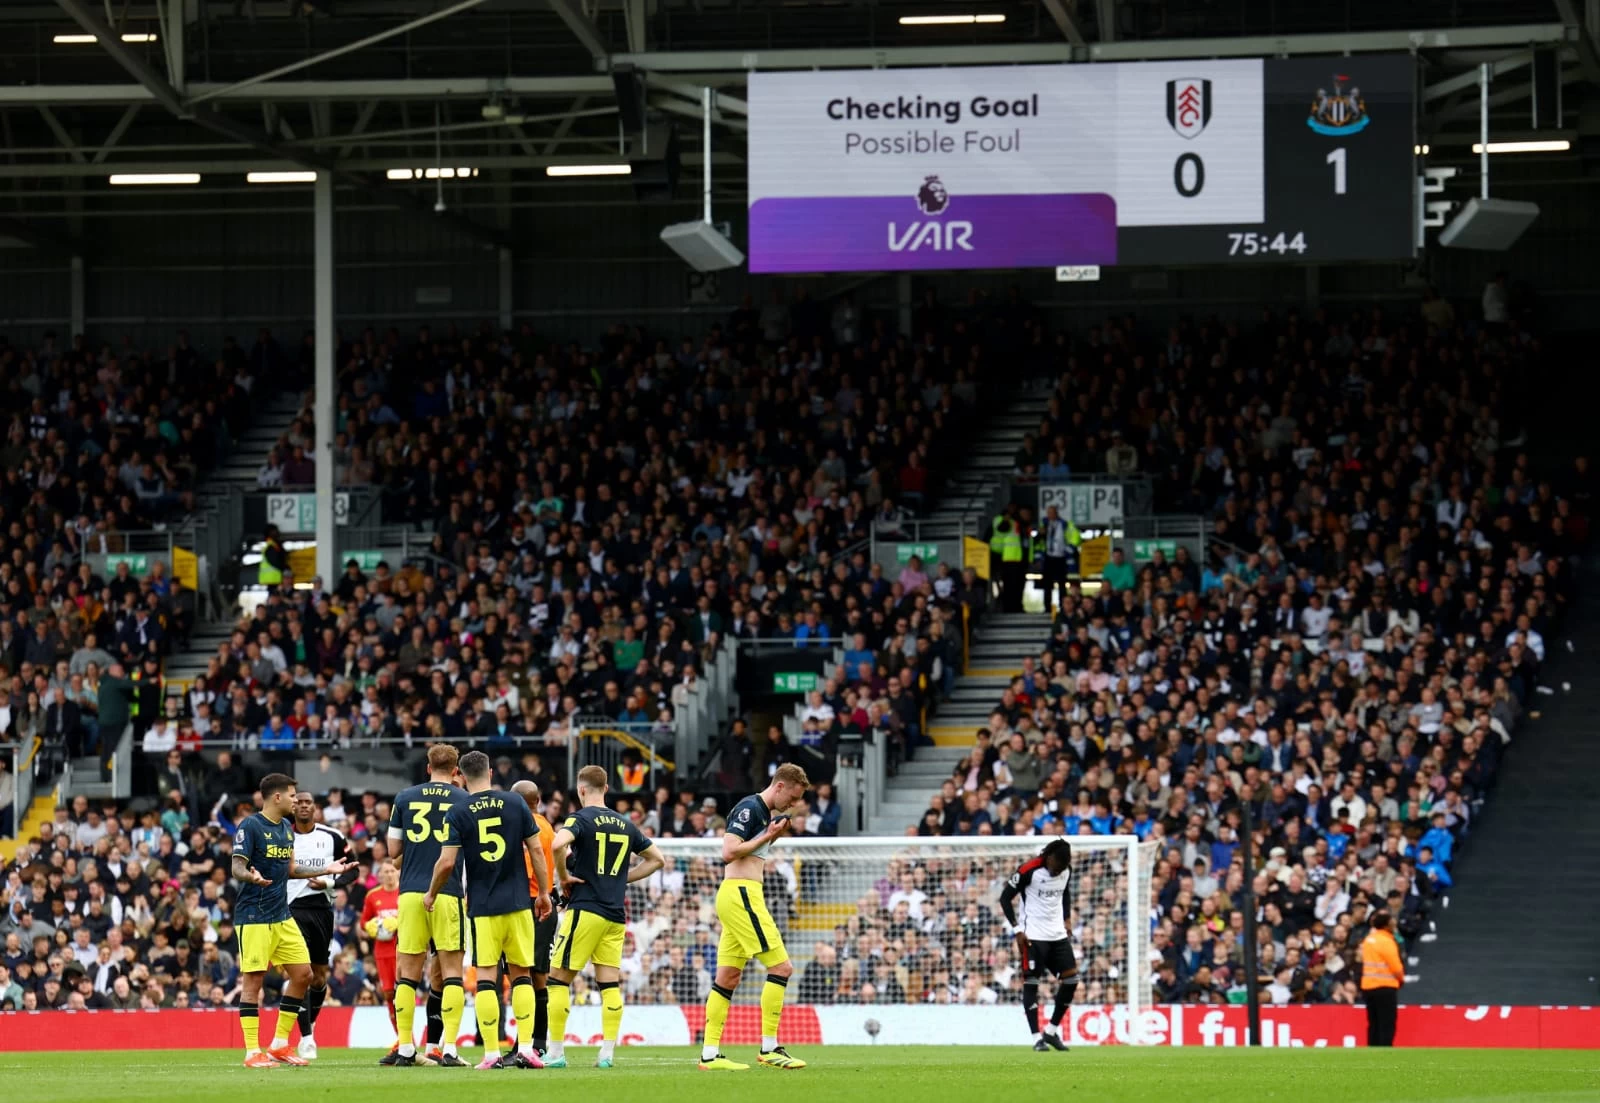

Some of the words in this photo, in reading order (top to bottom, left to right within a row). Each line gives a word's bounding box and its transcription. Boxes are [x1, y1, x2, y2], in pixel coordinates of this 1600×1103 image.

[826, 95, 961, 124] Checking
[969, 93, 1038, 118] Goal
[845, 130, 955, 155] Possible
[964, 128, 1020, 153] Foul
[1173, 152, 1205, 198] 0
[1326, 147, 1347, 195] 1
[887, 221, 975, 252] VAR
[1227, 231, 1308, 256] 75:44
[269, 498, 297, 519] P2
[1041, 488, 1068, 510] P3
[1093, 487, 1121, 511] P4
[421, 787, 452, 798] BURN
[593, 815, 626, 831] KRAFTH
[477, 816, 507, 862] 5
[595, 831, 630, 876] 17
